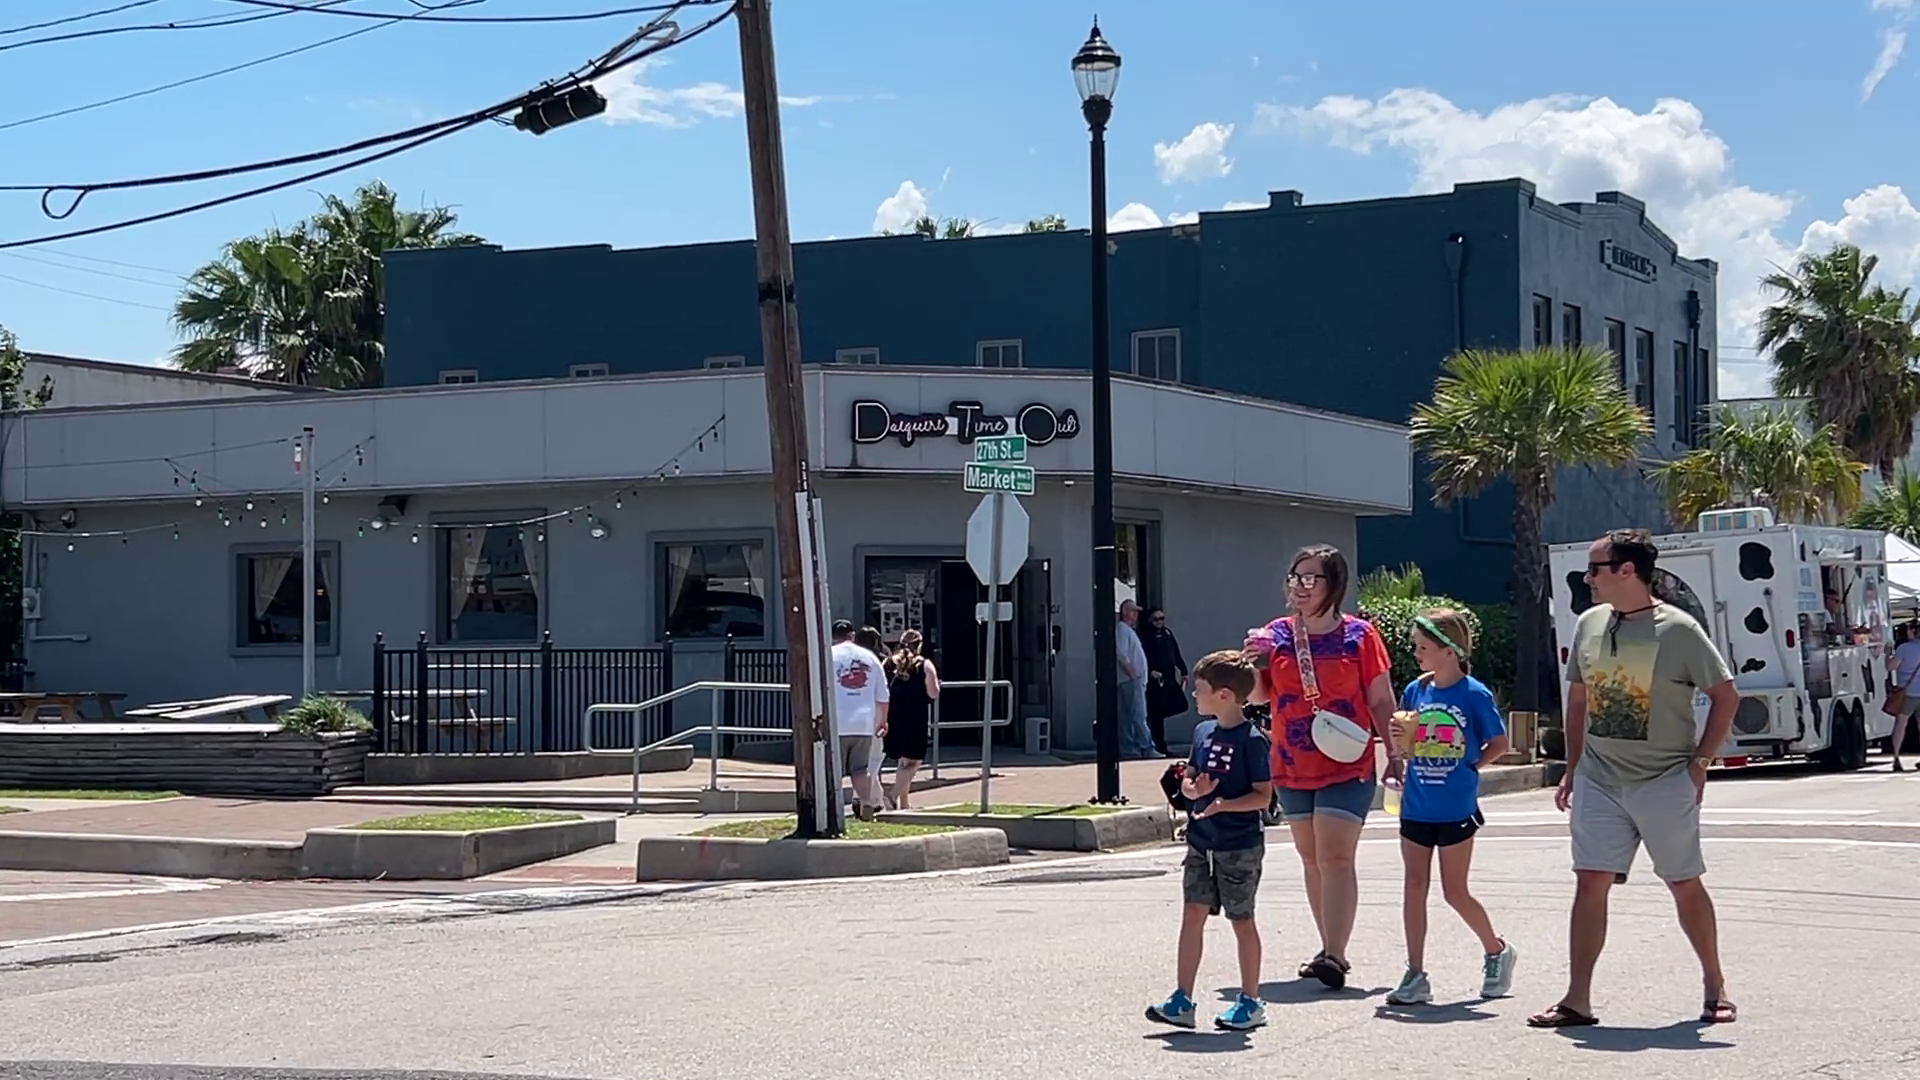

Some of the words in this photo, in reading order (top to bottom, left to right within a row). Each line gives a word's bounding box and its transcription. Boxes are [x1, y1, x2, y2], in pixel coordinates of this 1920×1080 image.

[956, 405, 1005, 438] Time
[1019, 404, 1077, 444] Out
[976, 441, 999, 461] 27th
[1000, 440, 1012, 460] St
[967, 466, 1016, 490] Market
